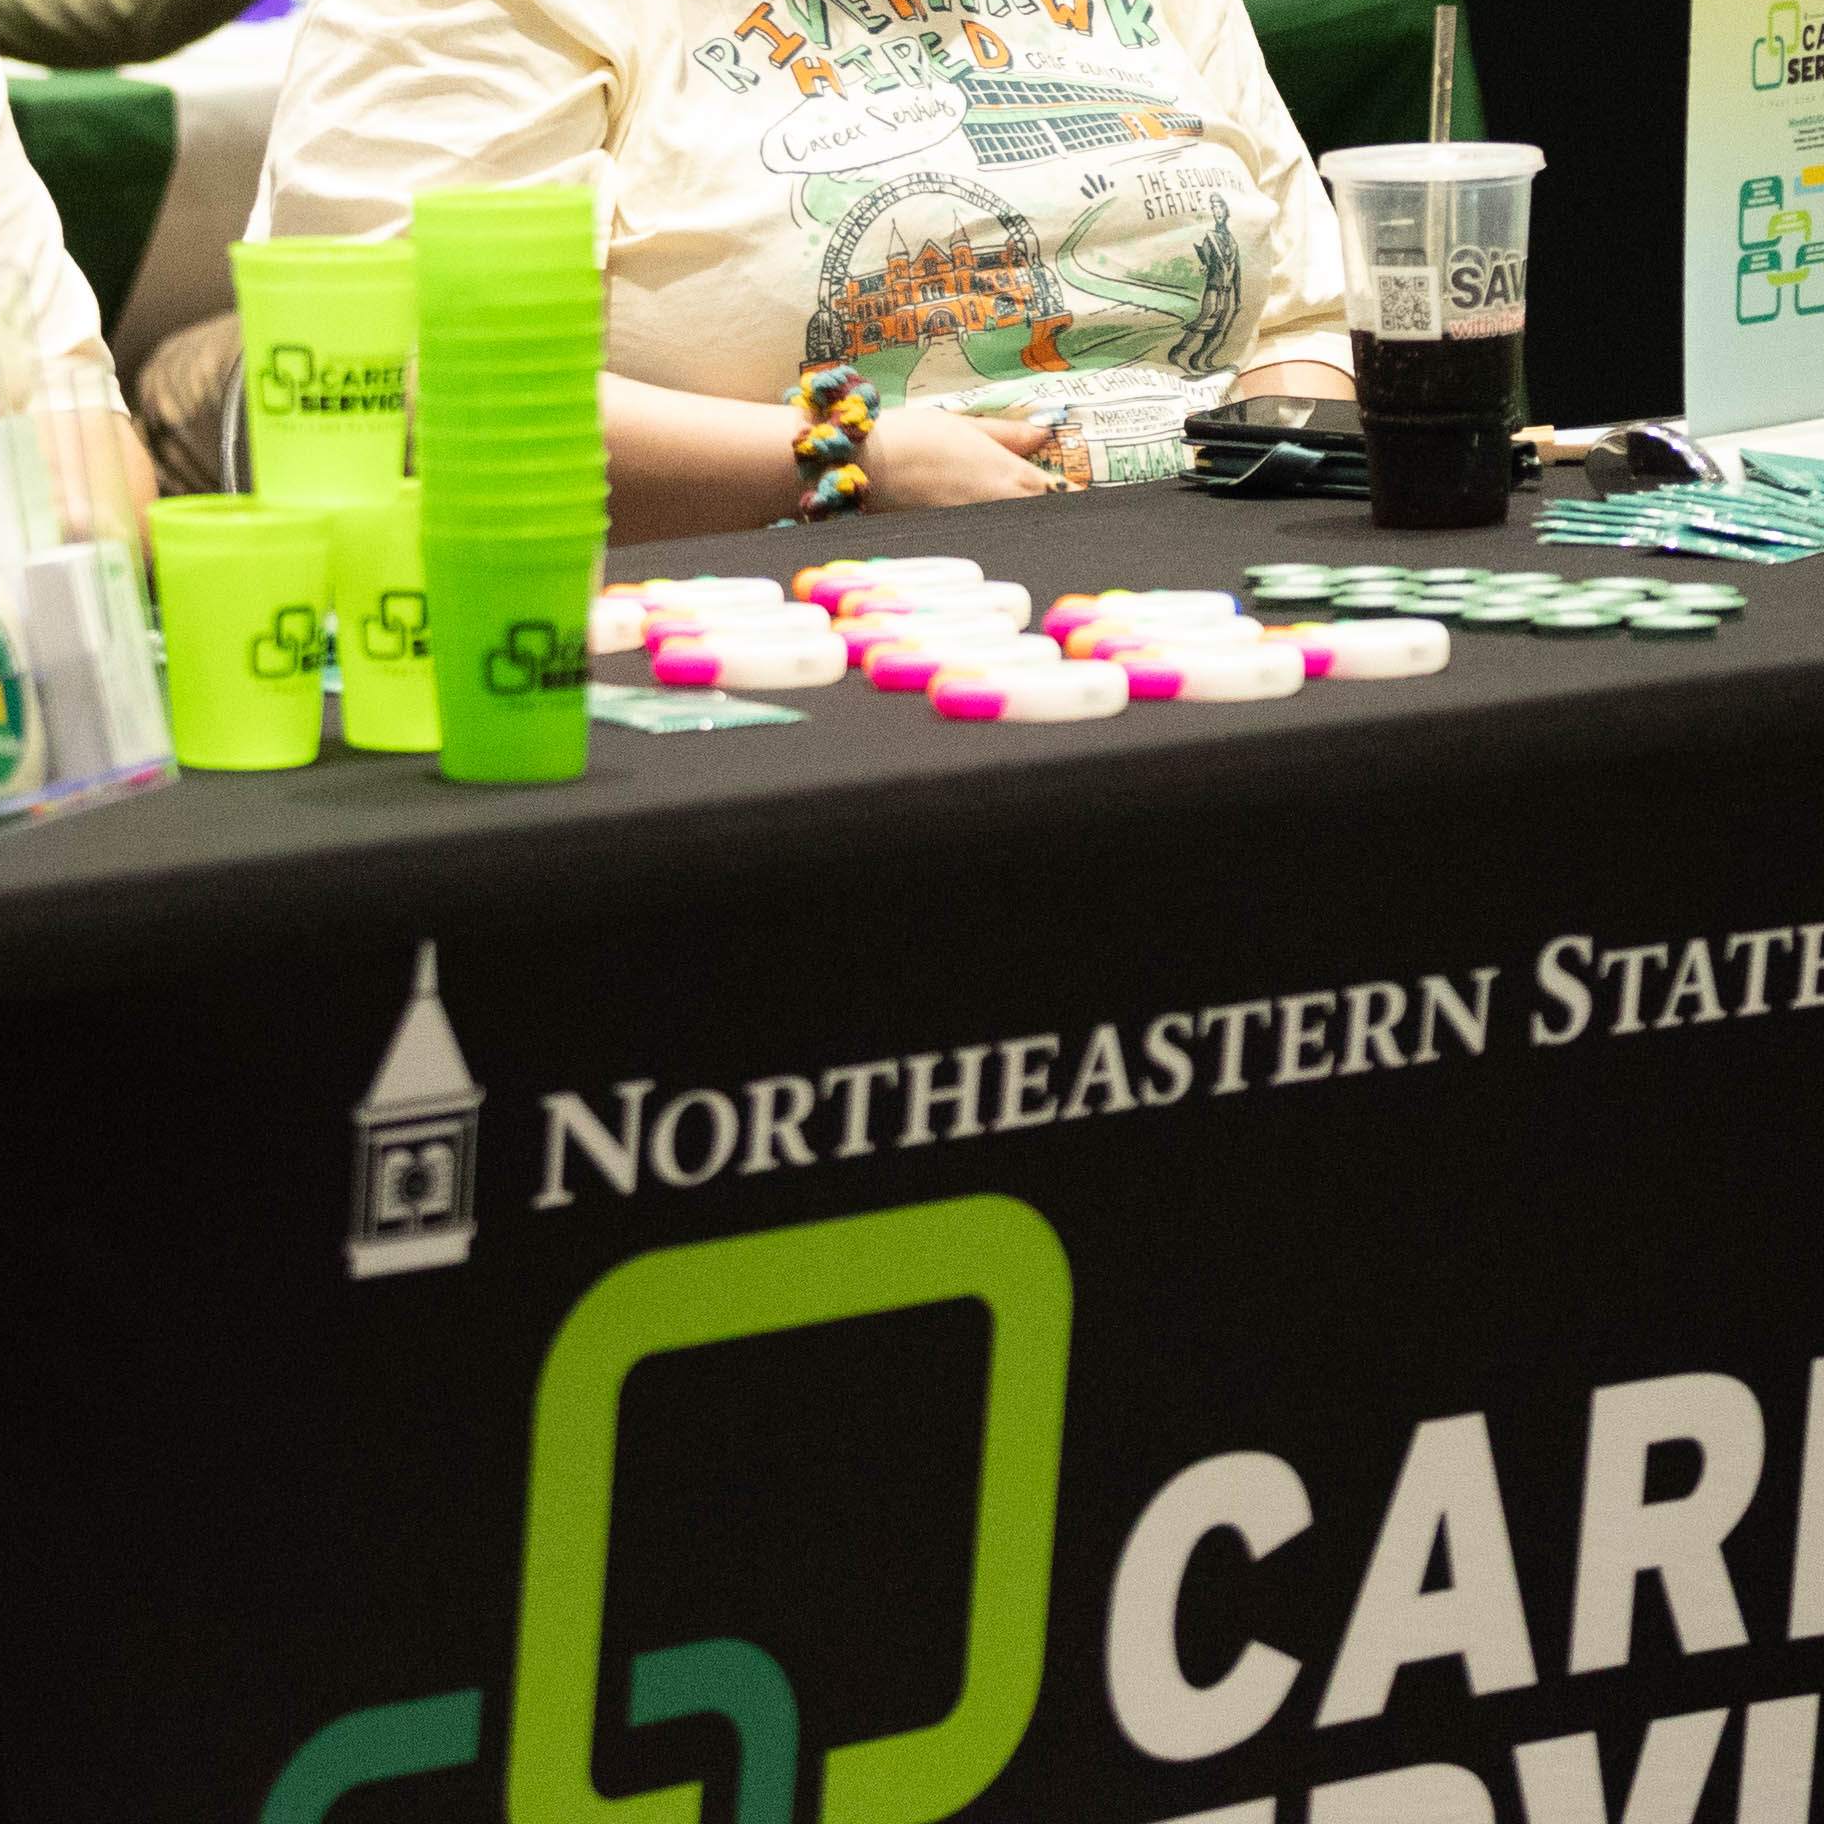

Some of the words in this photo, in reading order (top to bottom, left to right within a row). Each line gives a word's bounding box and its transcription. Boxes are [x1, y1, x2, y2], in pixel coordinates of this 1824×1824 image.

[790, 20, 1014, 101] HIRED
[782, 124, 868, 162] Career
[1137, 170, 1172, 195] THE
[1143, 191, 1206, 220] STATUE
[533, 965, 1499, 1210] NORTHEASTERN
